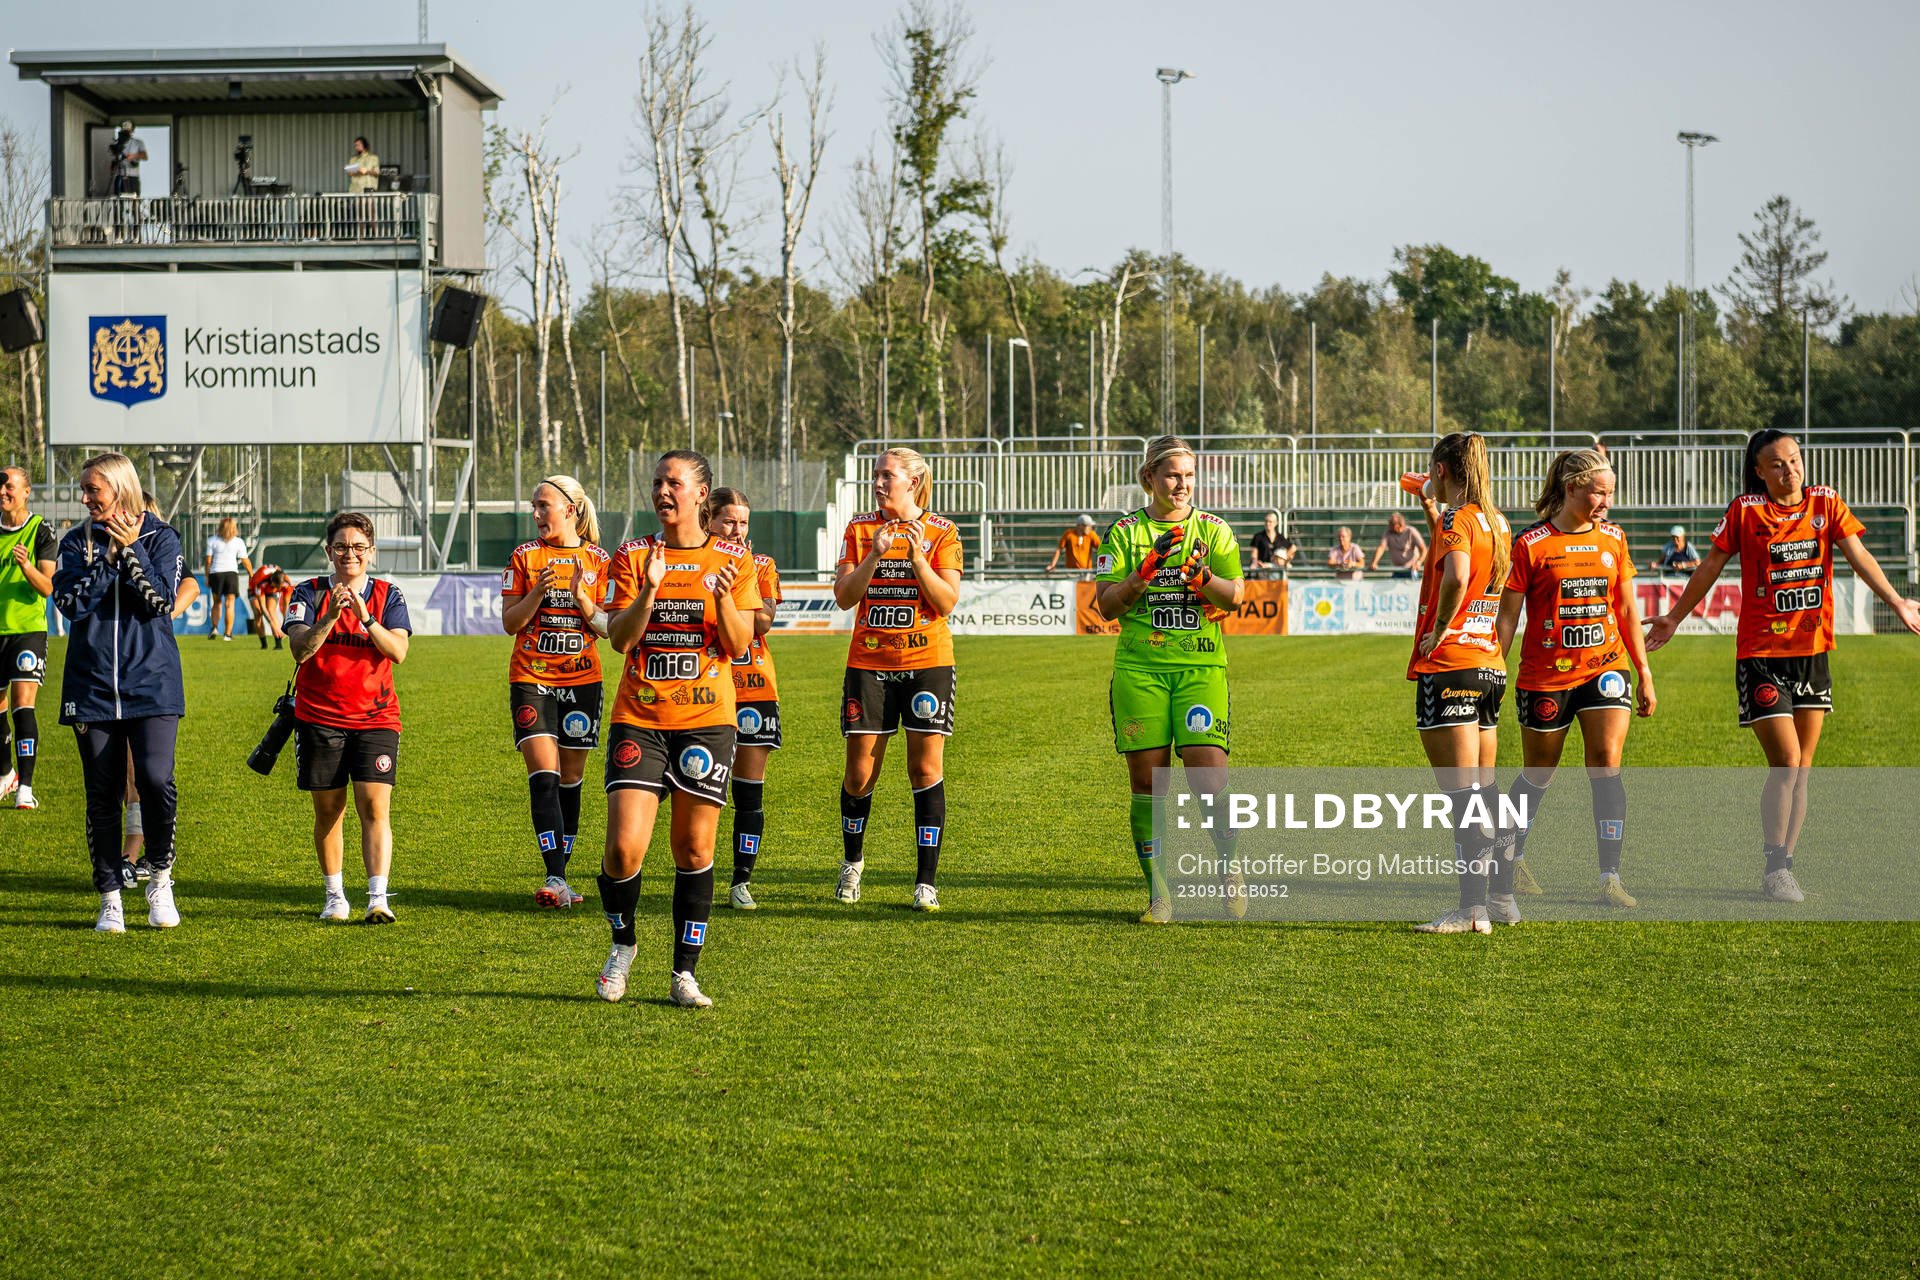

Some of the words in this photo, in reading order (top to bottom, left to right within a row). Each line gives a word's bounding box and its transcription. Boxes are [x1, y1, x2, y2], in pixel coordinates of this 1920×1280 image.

[185, 326, 380, 355] Kristianstads
[185, 362, 316, 388] kommun
[929, 516, 950, 528] MAXI
[1117, 516, 1138, 528] MAXI
[1524, 527, 1548, 542] MAXI
[516, 541, 539, 554] MAXI
[588, 544, 609, 561] MAXI
[620, 539, 647, 554] MAXI
[716, 541, 744, 555] MAXI
[1770, 540, 1818, 554] Sparbanken
[1783, 551, 1808, 562] Skåne
[876, 560, 912, 569] parbanke
[882, 569, 905, 578] Skåne
[1159, 577, 1184, 586] Skåne
[1562, 579, 1608, 588] Sparbanken
[545, 590, 574, 598] parban
[1574, 588, 1596, 598] Skåne
[550, 599, 574, 608] Skåne
[651, 600, 704, 612] parbanken
[1030, 594, 1065, 610] AB
[1354, 589, 1409, 617] Ljus
[660, 611, 688, 622] Skåne
[948, 614, 976, 626] NA
[982, 614, 1066, 626] PERSSON
[908, 633, 928, 648] Kb
[1196, 638, 1214, 652] Kb
[574, 656, 592, 672] Kb
[747, 674, 765, 688] Kb
[692, 687, 716, 705] Kb
[764, 717, 776, 732] 14
[1216, 718, 1227, 735] 33
[712, 763, 728, 783] 21
